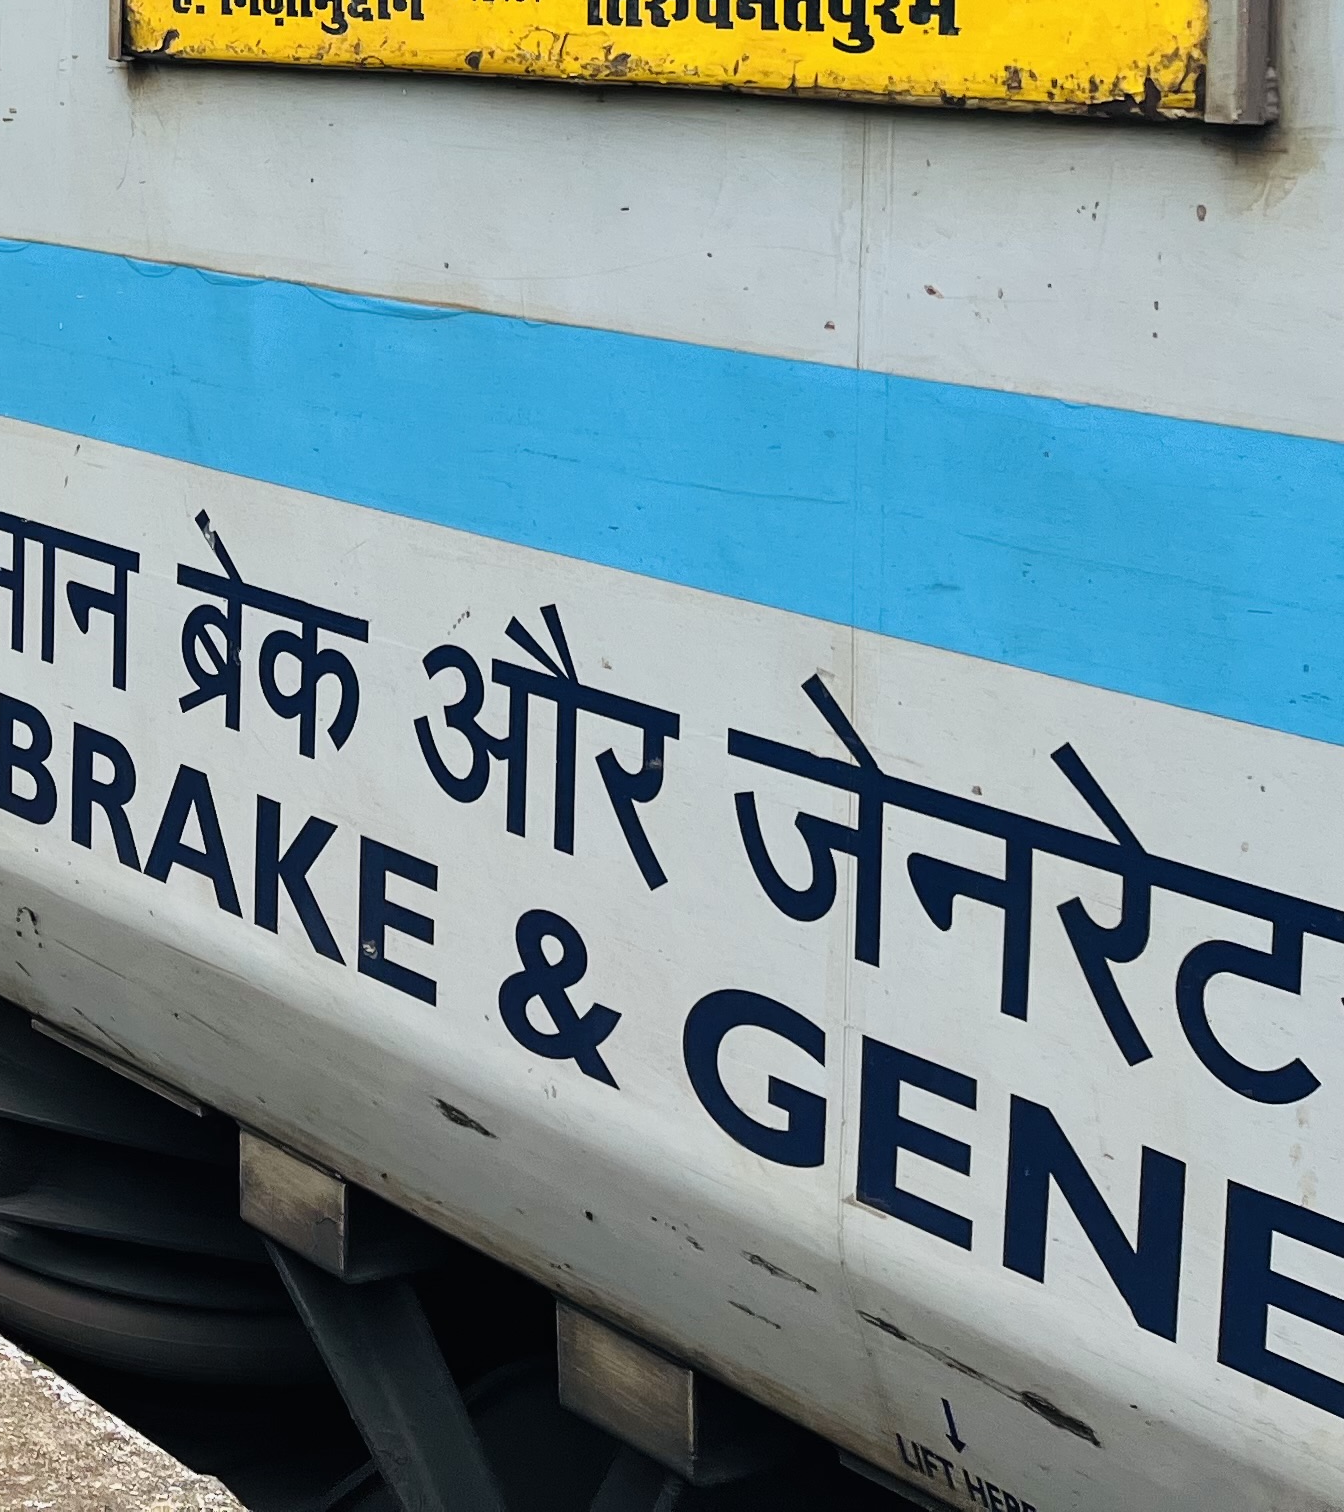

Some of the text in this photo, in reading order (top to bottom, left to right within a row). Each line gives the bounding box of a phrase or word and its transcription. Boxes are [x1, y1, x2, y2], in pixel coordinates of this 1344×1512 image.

[176, 509, 370, 760] ब्रेक
[413, 603, 681, 891] और
[727, 673, 1344, 1106] जेनरेट
[498, 908, 622, 1091] &
[895, 1432, 955, 1491] LIFT
